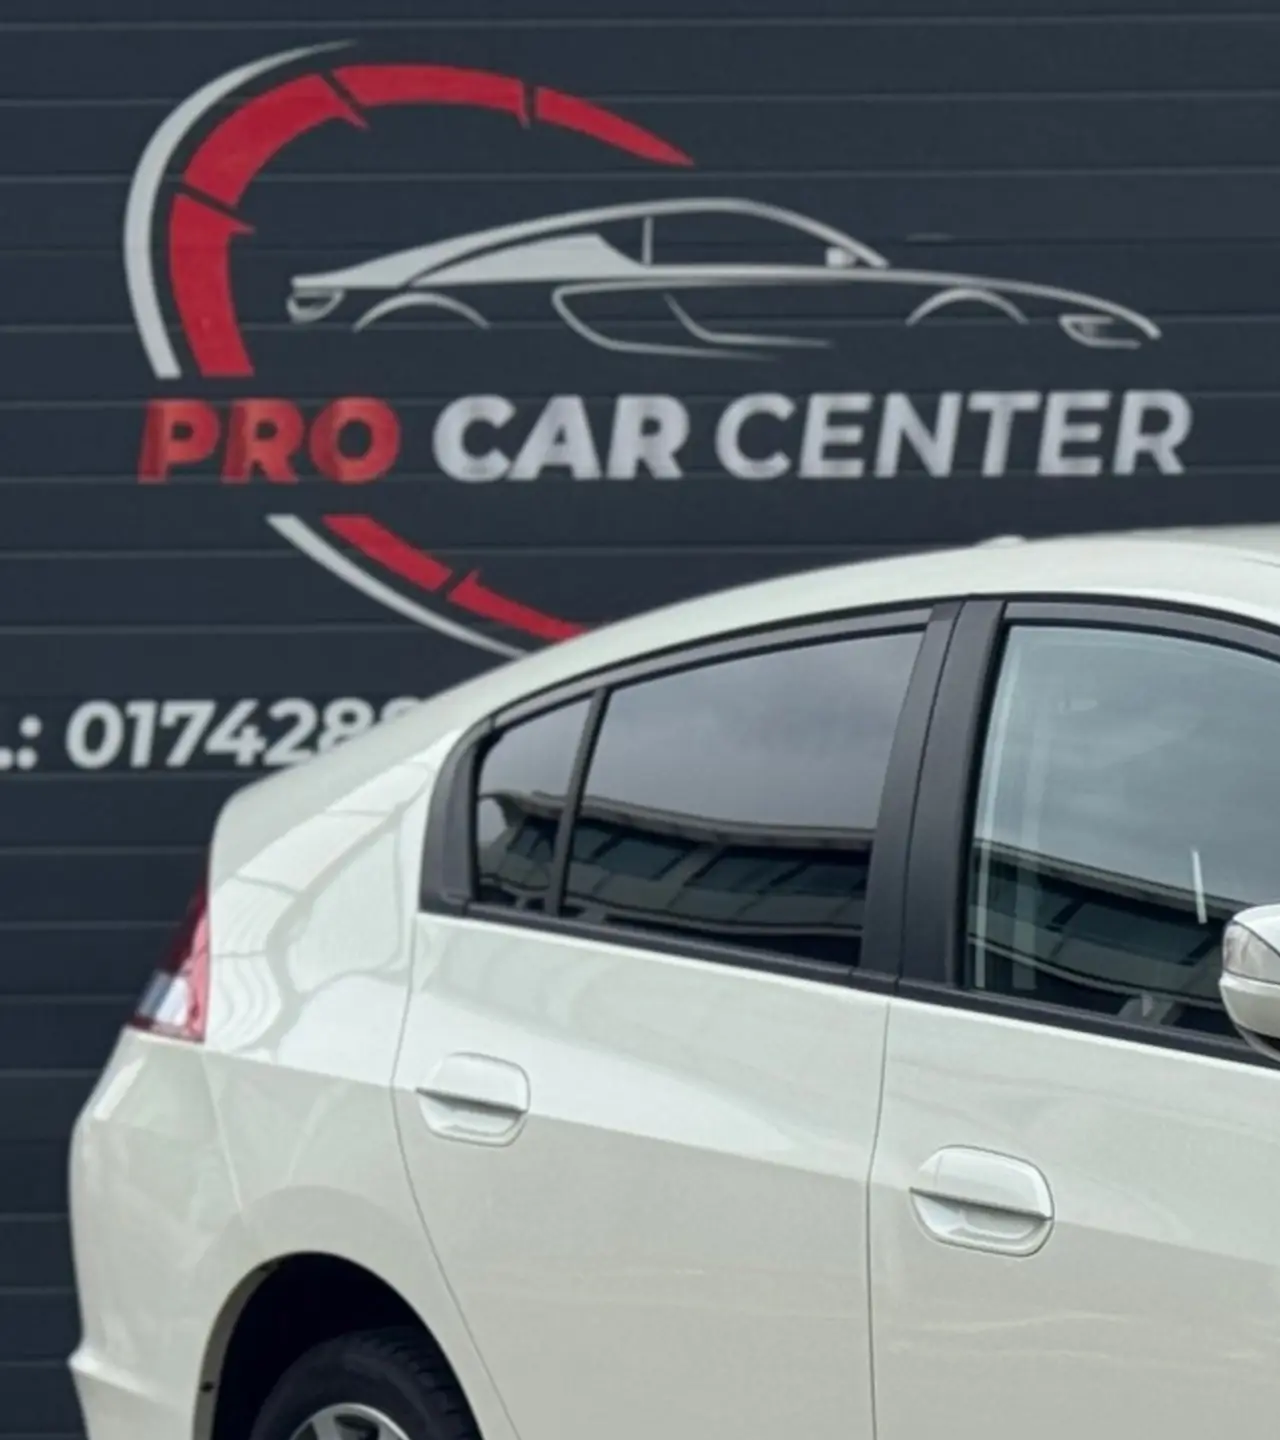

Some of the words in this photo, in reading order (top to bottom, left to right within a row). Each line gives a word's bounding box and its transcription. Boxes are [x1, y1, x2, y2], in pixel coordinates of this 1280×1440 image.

[138, 396, 400, 485] PRO
[432, 394, 691, 483] CAR
[715, 389, 1192, 480] CENTER
[64, 697, 424, 770] 017428
